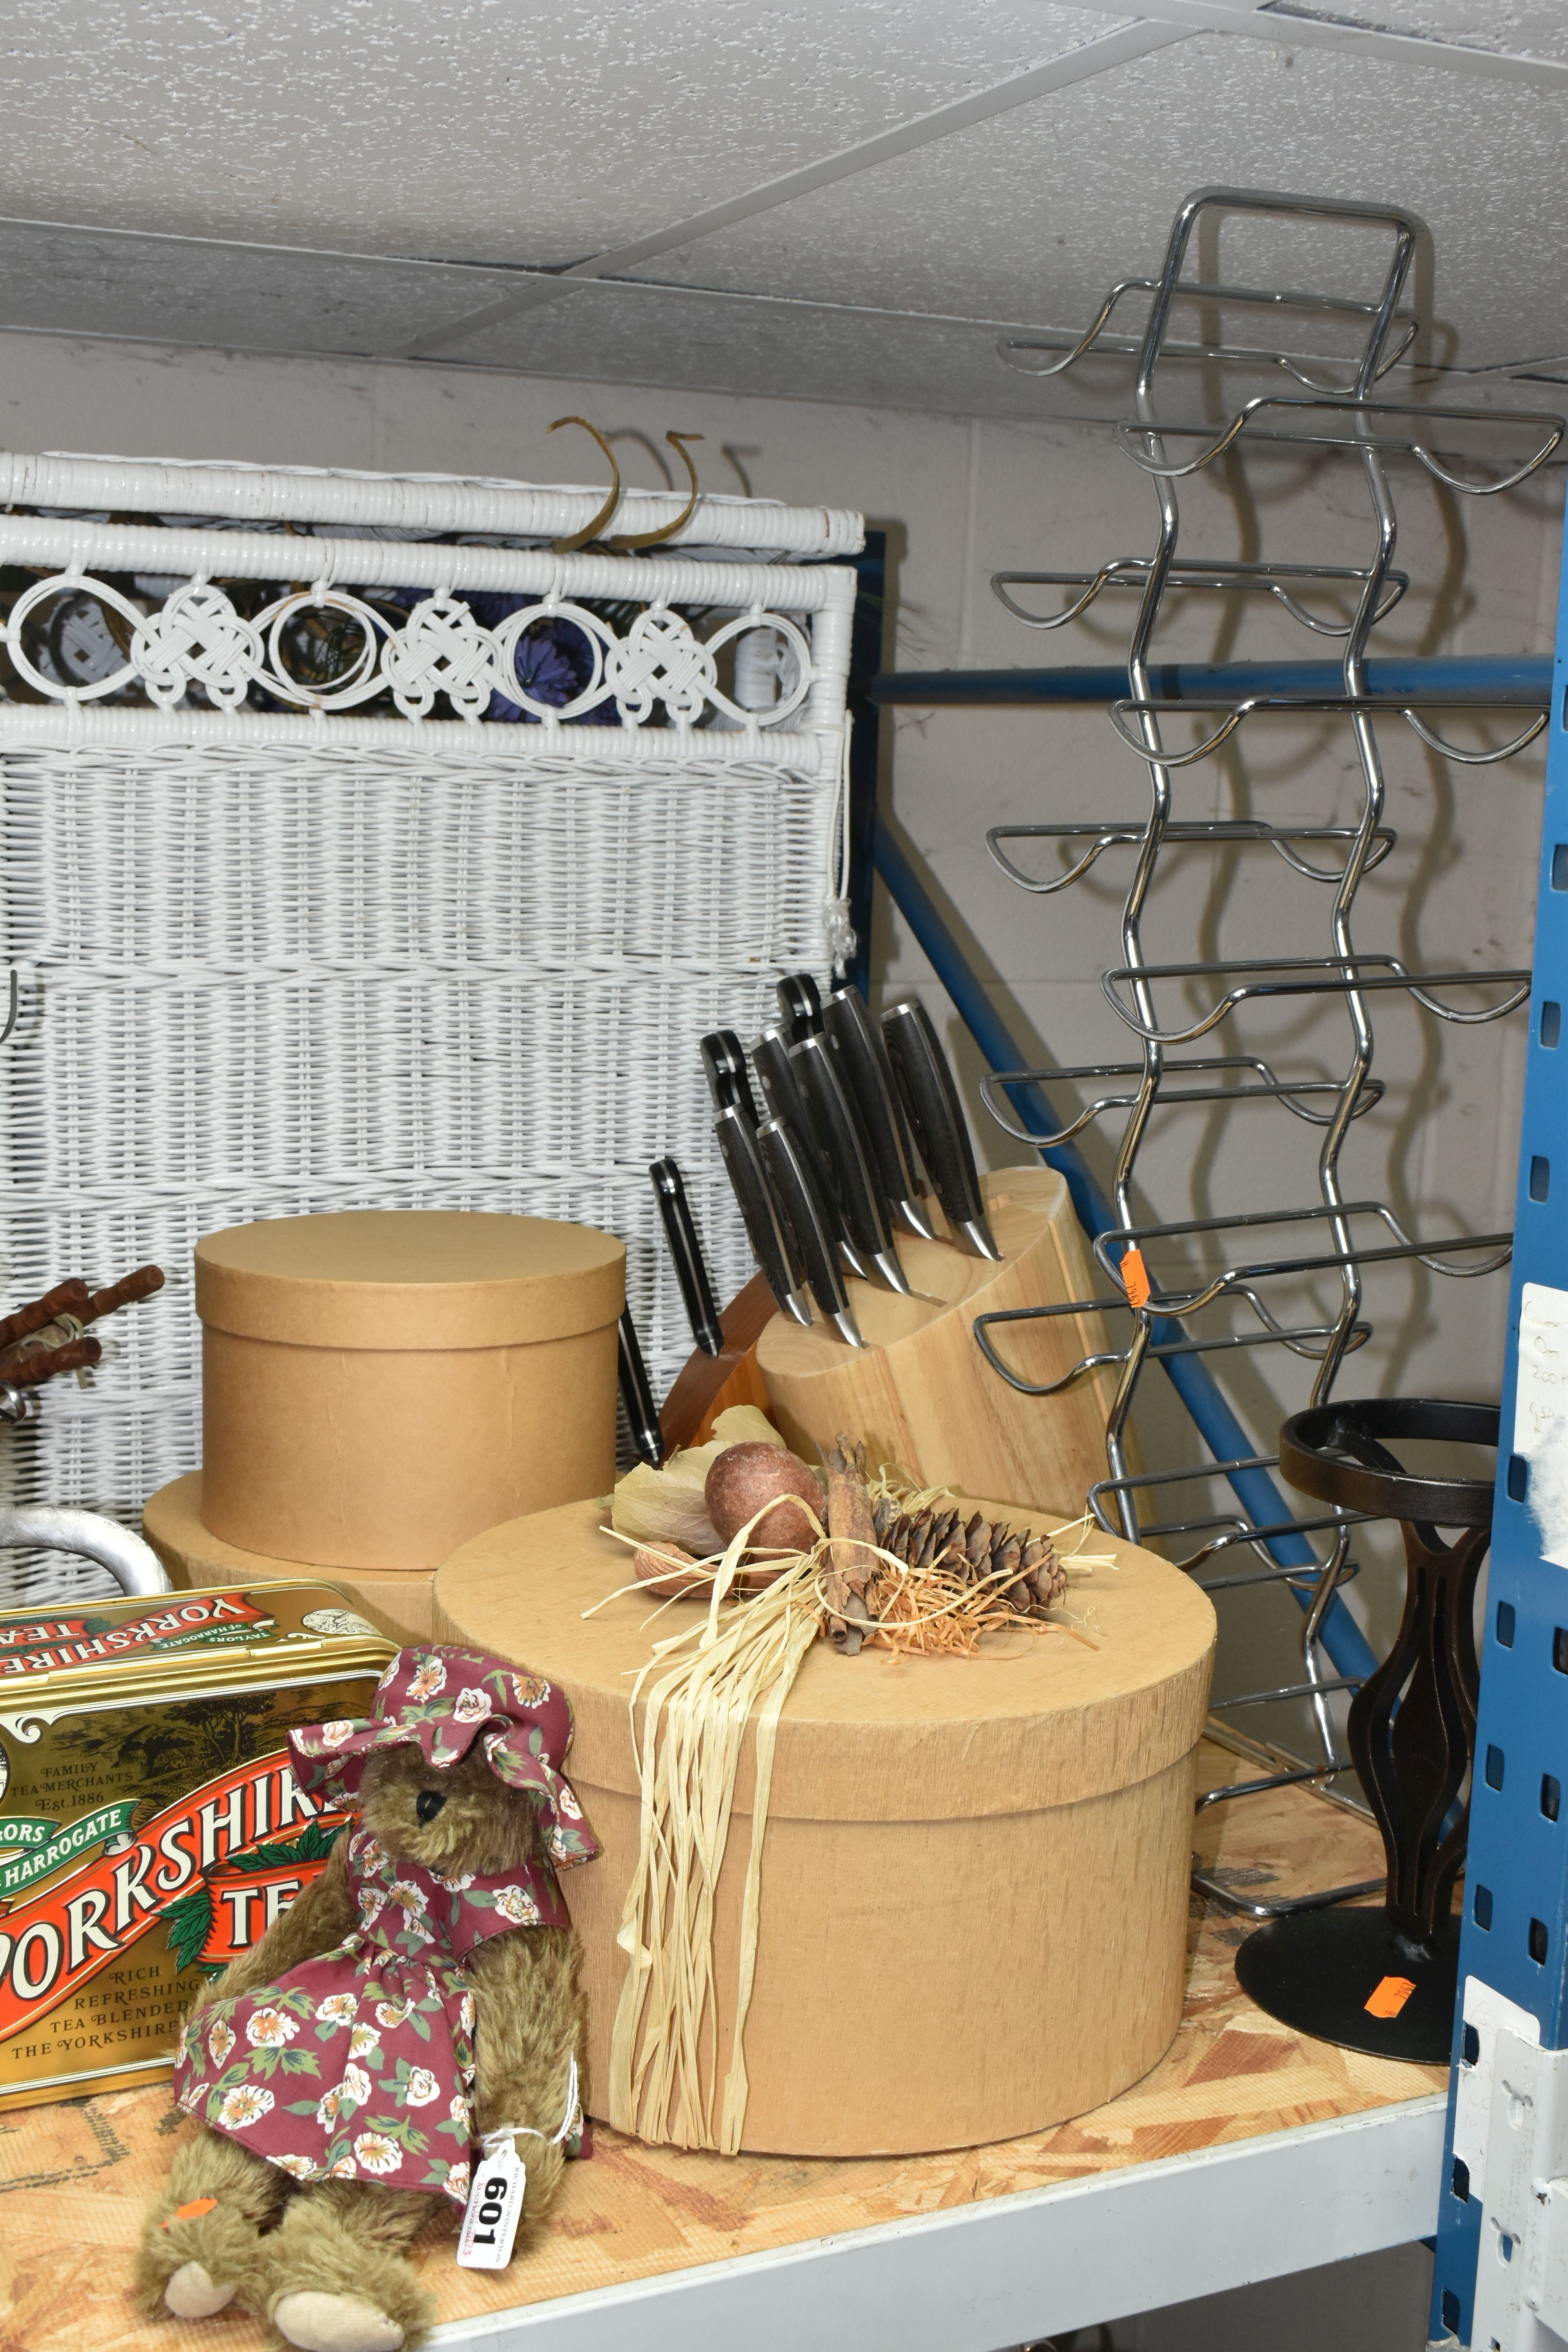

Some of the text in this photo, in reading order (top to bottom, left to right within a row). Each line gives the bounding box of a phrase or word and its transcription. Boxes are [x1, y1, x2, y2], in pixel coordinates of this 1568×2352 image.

[1126, 1281, 1140, 1306] 7967
[0, 1598, 247, 1673] YORKSHIRE
[160, 1628, 228, 1649] HARROGATE
[209, 1632, 270, 1642] TAYLORS
[10, 1772, 133, 1797] TEA MERCHANTS
[40, 1762, 98, 1777] FAMILY
[0, 1824, 45, 1842] ORS
[5, 1809, 122, 1888] HARROGATE
[0, 1769, 338, 2000] ORKSHIR
[223, 1881, 299, 1945] TE
[109, 1966, 160, 1985] RICH
[74, 1979, 199, 2010] REFRESHING
[50, 2000, 189, 2033] TEA BLENDED
[12, 2020, 178, 2059] THE YORKSHIRE
[464, 2181, 481, 2243] AUCTIONEERS
[473, 2177, 508, 2245] 601
[495, 2167, 520, 2263] RICHARD WINTERTON
